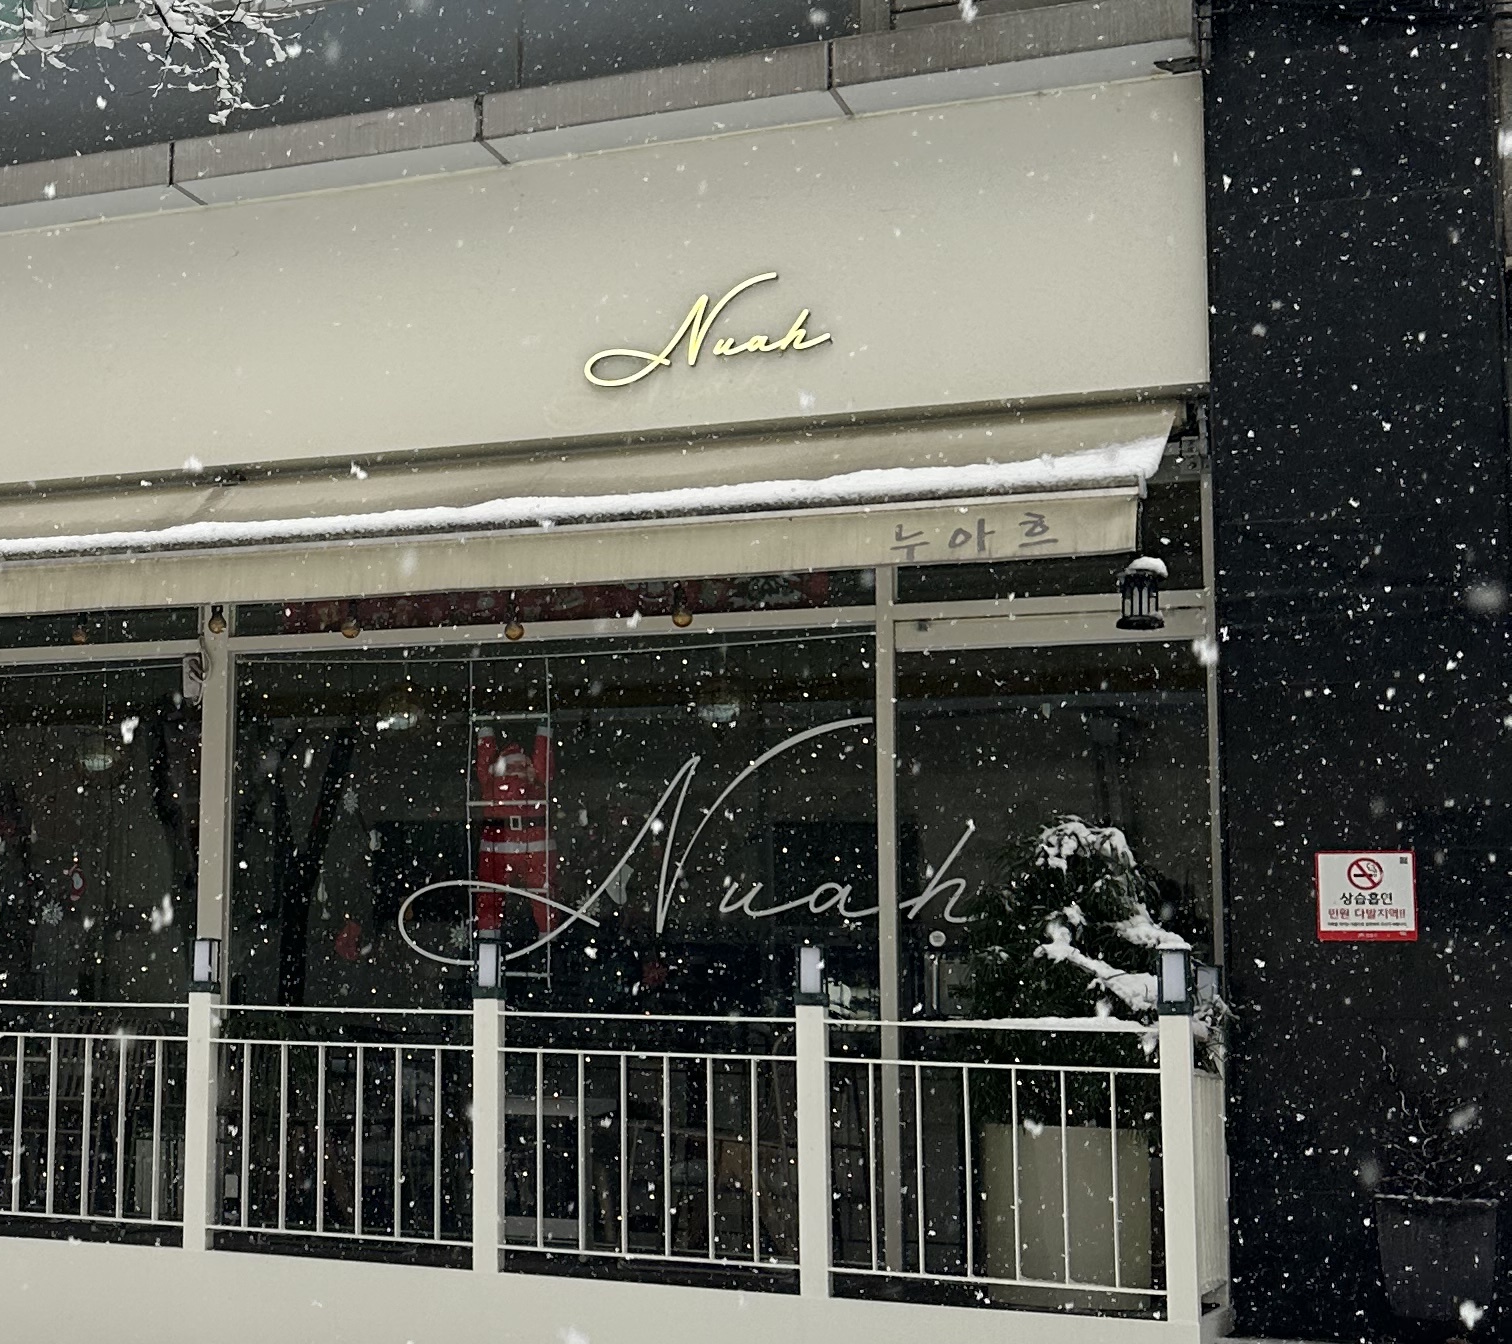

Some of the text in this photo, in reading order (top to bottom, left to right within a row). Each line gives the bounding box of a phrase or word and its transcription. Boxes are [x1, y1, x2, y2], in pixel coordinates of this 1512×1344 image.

[584, 271, 832, 386] Nuah
[890, 512, 1059, 562] 누아흐
[398, 716, 986, 966] Nuah
[1340, 892, 1393, 906] 상습흡연
